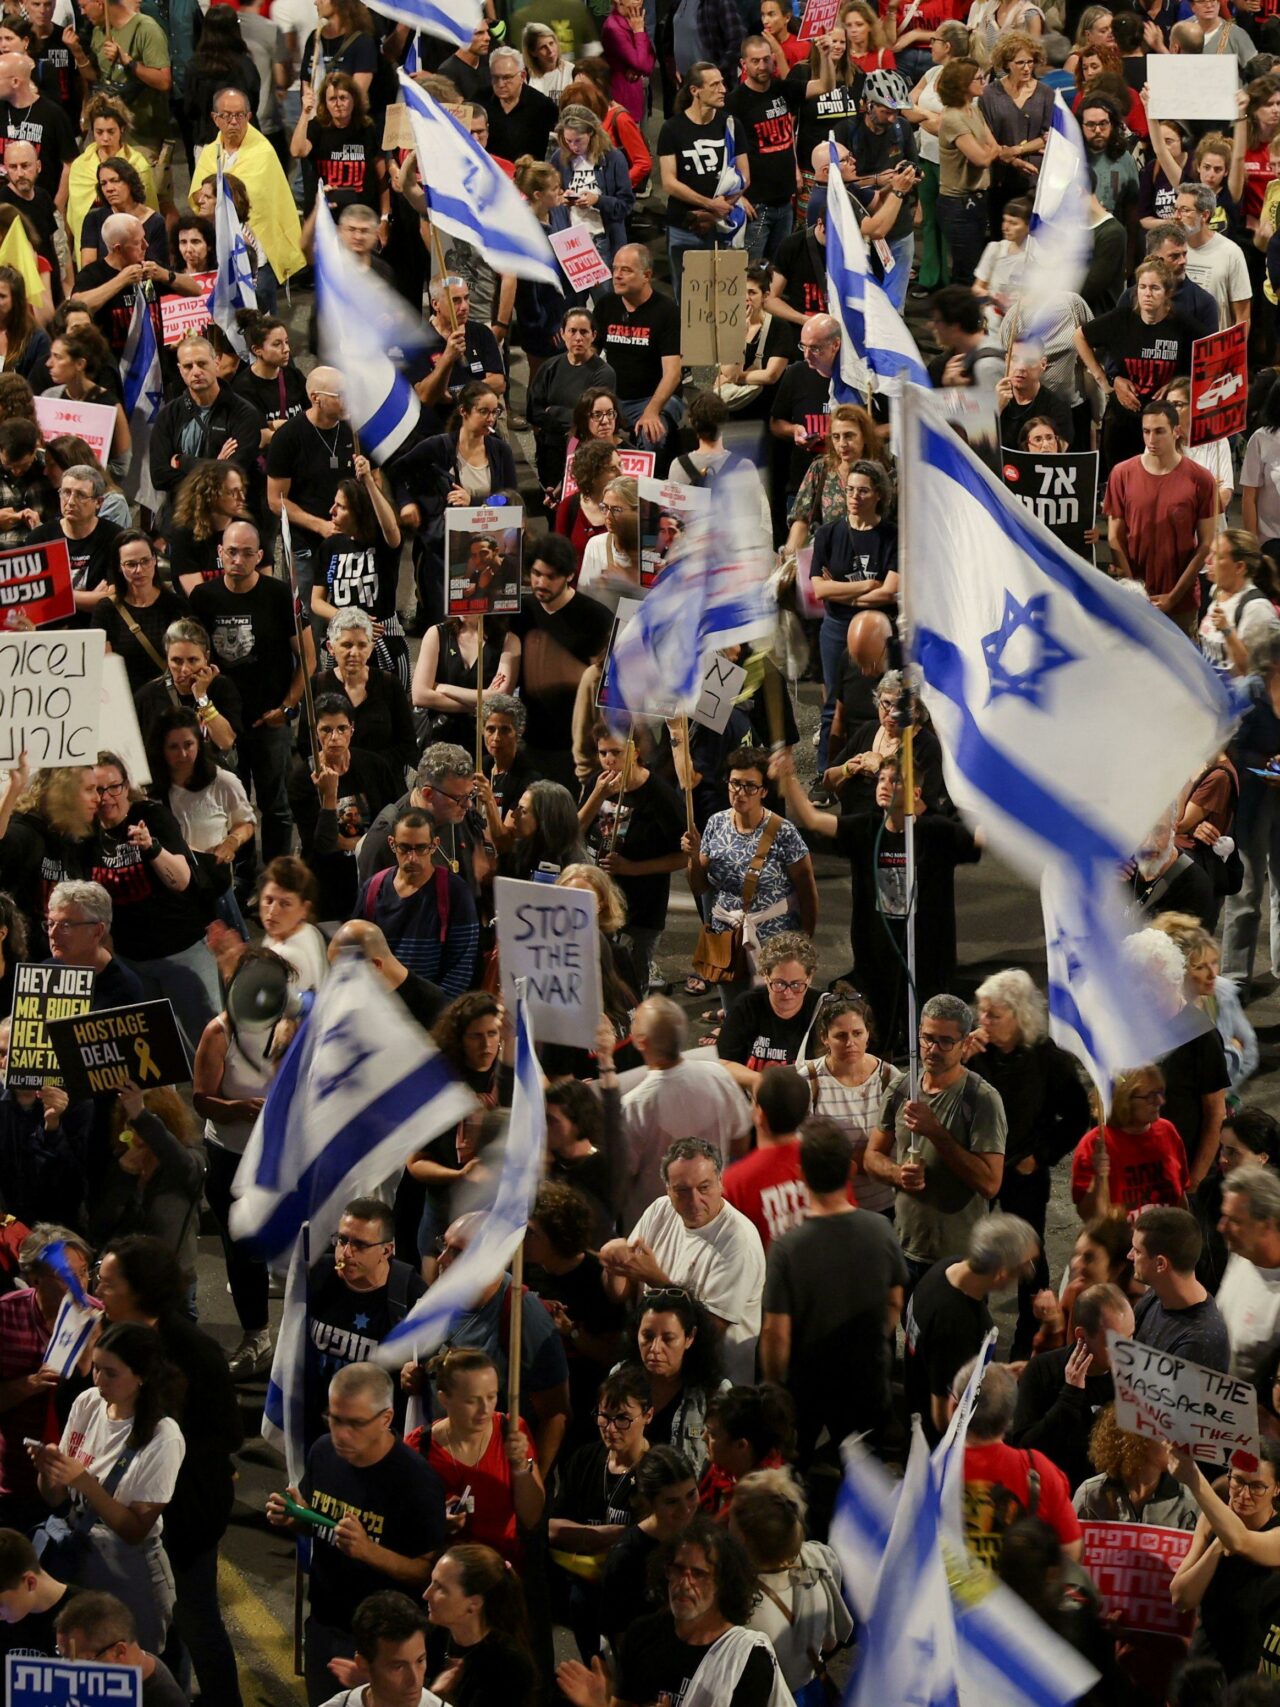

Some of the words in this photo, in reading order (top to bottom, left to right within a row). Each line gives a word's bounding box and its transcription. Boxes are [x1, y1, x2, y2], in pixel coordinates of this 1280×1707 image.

[179, 298, 207, 313] בקות
[606, 333, 649, 346] MINISTER
[1034, 464, 1077, 497] אל
[0, 684, 72, 720] סוח
[513, 904, 589, 942] STOP
[526, 942, 583, 971] THE
[19, 967, 53, 994] HEY
[55, 968, 93, 996] JOE!
[16, 995, 46, 1019] MR.
[13, 1020, 50, 1048] HEL
[73, 1012, 149, 1046] HOSTAGE
[12, 1050, 45, 1069] SAVE
[80, 1042, 125, 1068] DEAL
[766, 1048, 787, 1061] HOME
[87, 1064, 131, 1092] NOW
[1114, 1340, 1186, 1381] STOP
[1199, 1368, 1252, 1405] THE
[1117, 1371, 1238, 1426] MASSACRE
[1084, 1528, 1137, 1549] רפיח
[1163, 1535, 1193, 1556] זה
[1085, 1547, 1165, 1568] החטופי
[13, 1664, 134, 1698] בחירות
